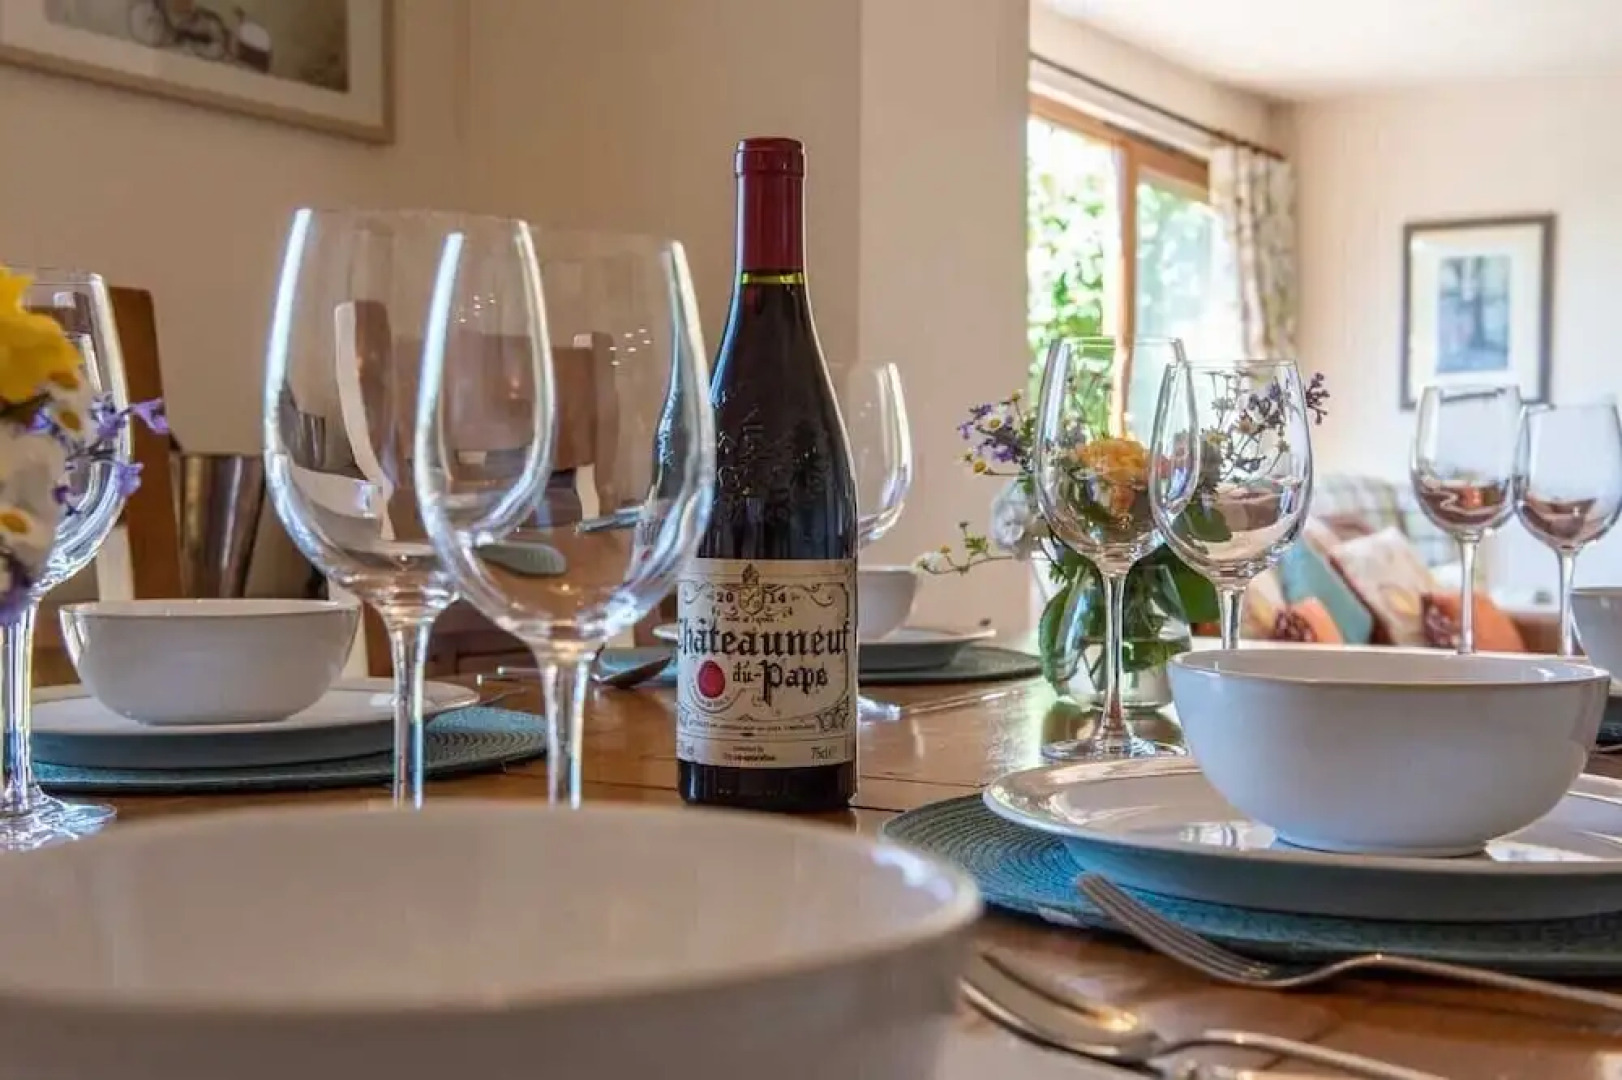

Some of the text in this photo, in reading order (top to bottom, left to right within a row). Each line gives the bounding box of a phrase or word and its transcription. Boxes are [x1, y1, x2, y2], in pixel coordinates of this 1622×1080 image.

[716, 592, 785, 603] 20 14
[678, 618, 850, 655] hâteauneuf
